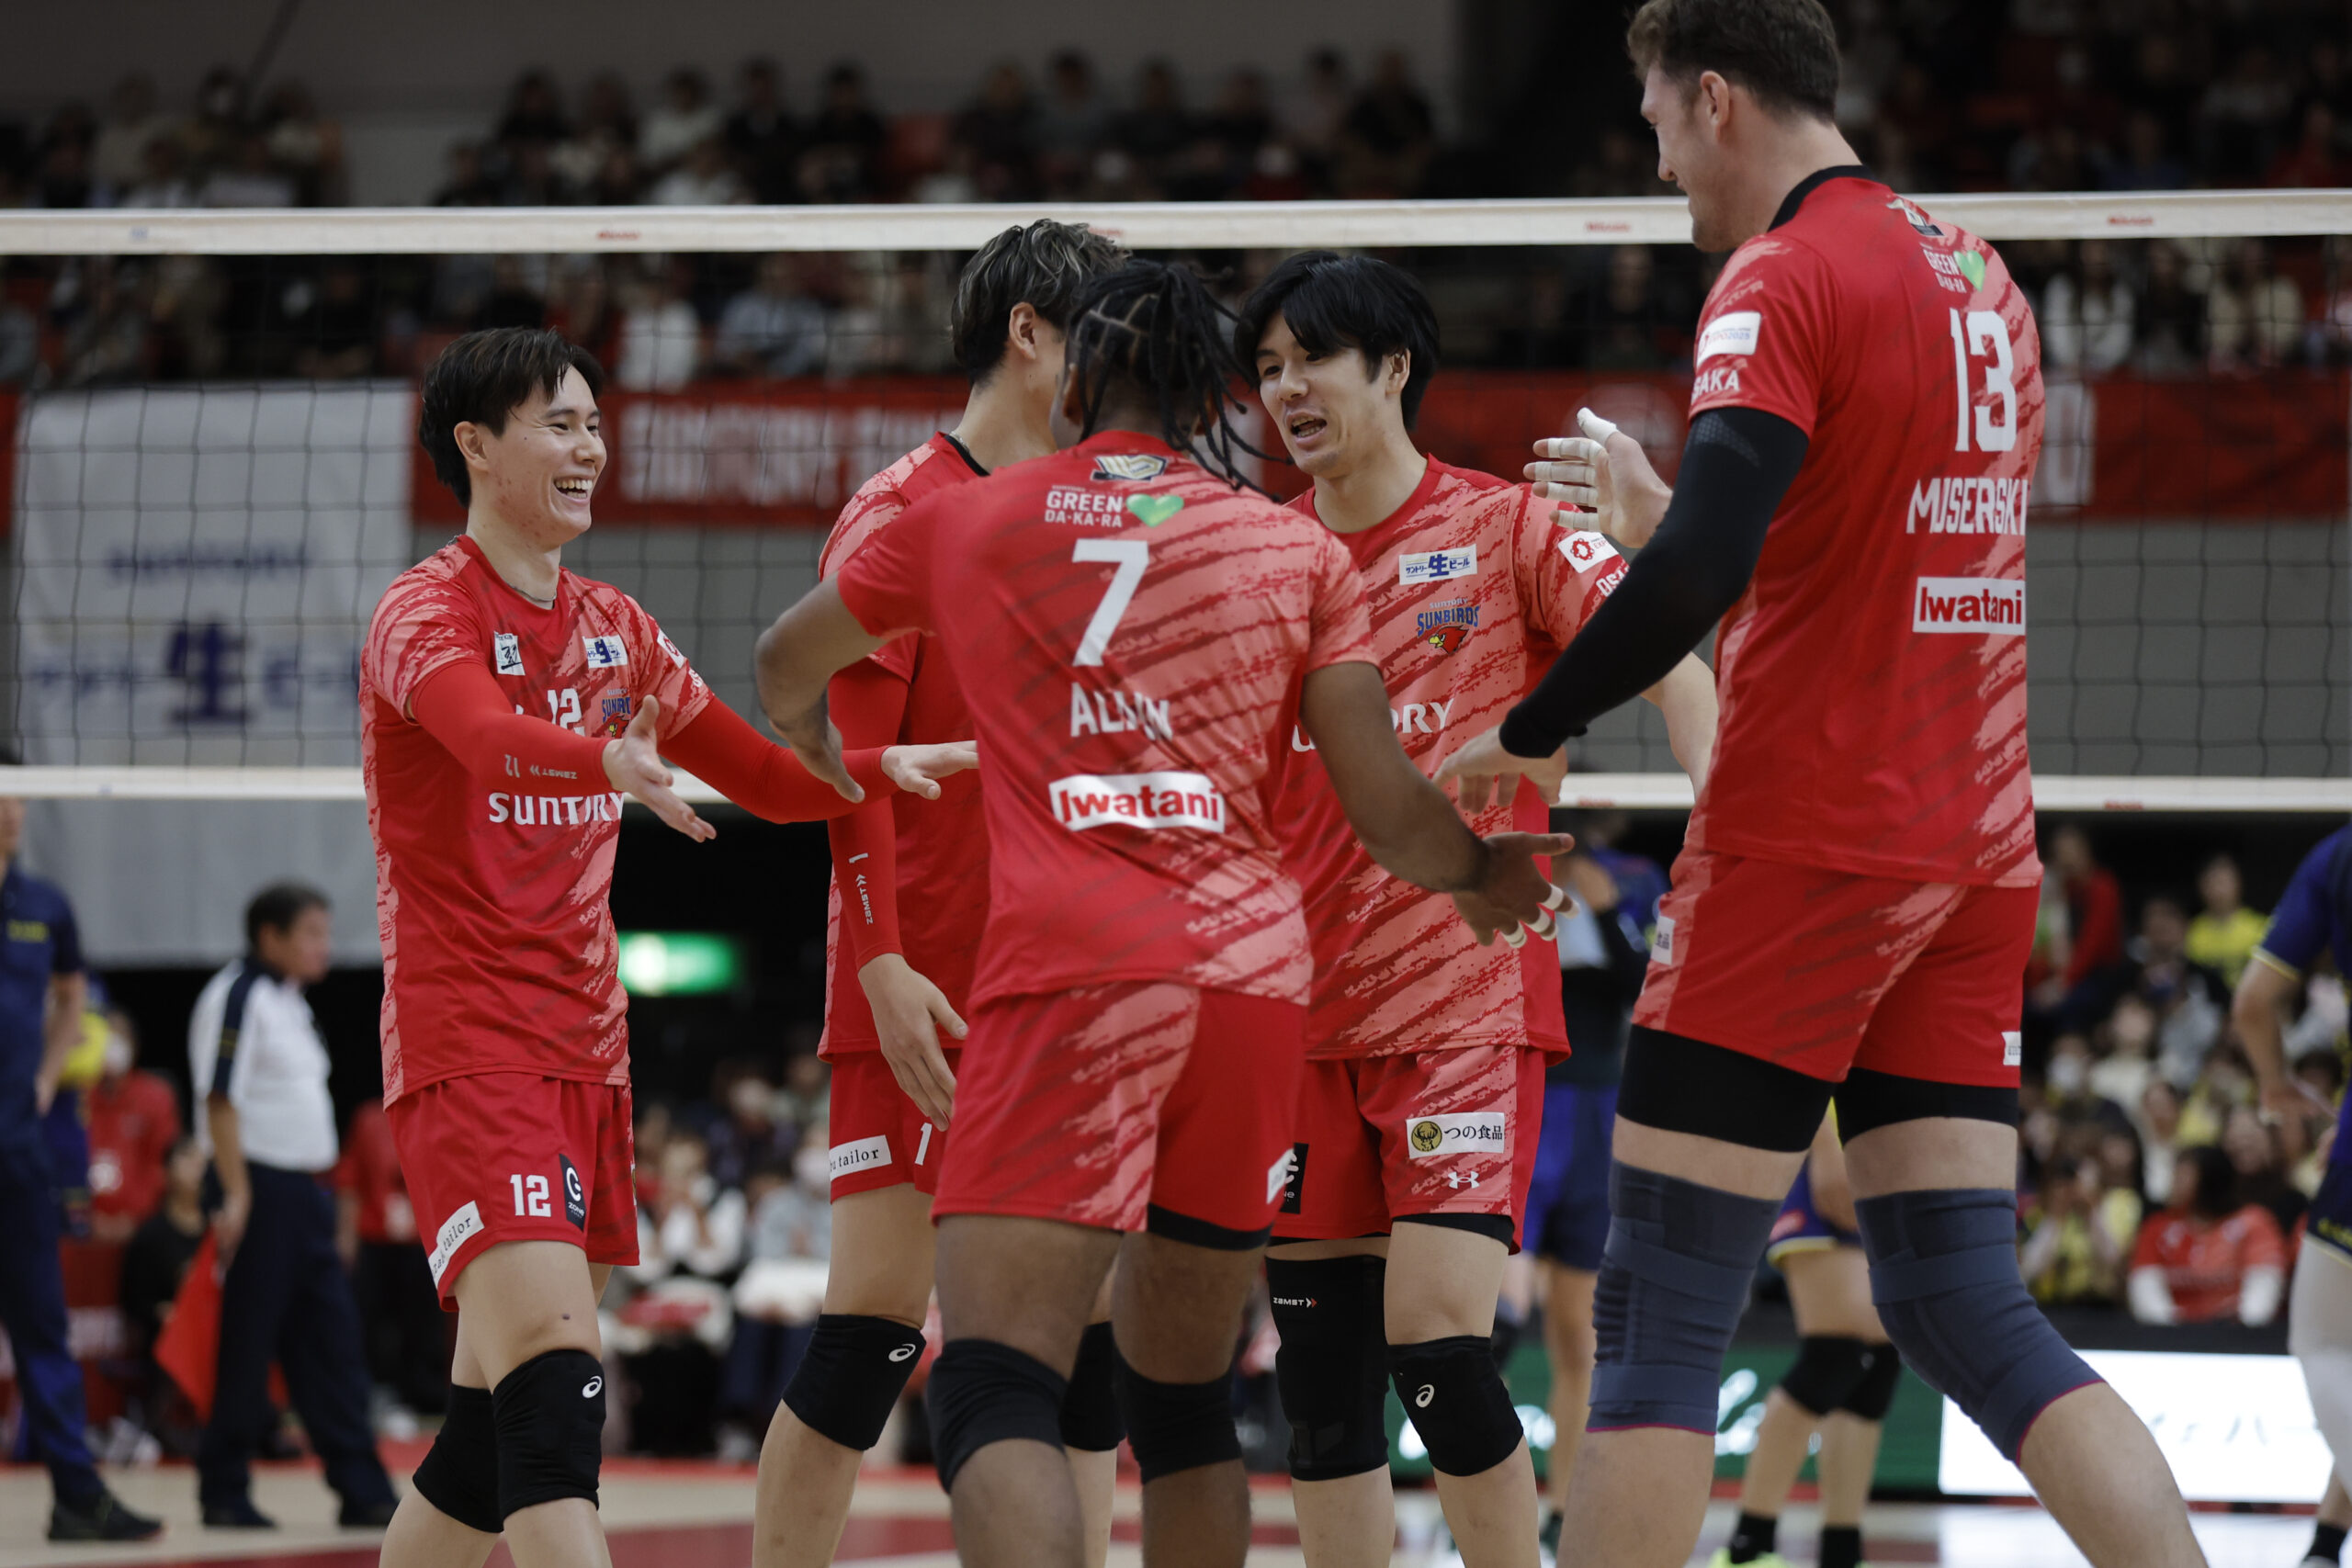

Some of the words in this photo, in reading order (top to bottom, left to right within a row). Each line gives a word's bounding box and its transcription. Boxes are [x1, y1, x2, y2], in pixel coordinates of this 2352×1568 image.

[1950, 308, 2017, 452] 13
[1046, 491, 1123, 513] GREEN
[1071, 538, 1149, 667] 7
[1417, 604, 1481, 637] SUNBIRDS
[1919, 587, 2021, 626] Iwatani
[548, 688, 586, 737] 12
[1059, 784, 1220, 823] Iwatani
[915, 1122, 933, 1166] 1
[1443, 1123, 1503, 1142] つの食品
[838, 1148, 879, 1168] tailor
[510, 1174, 551, 1217] 12
